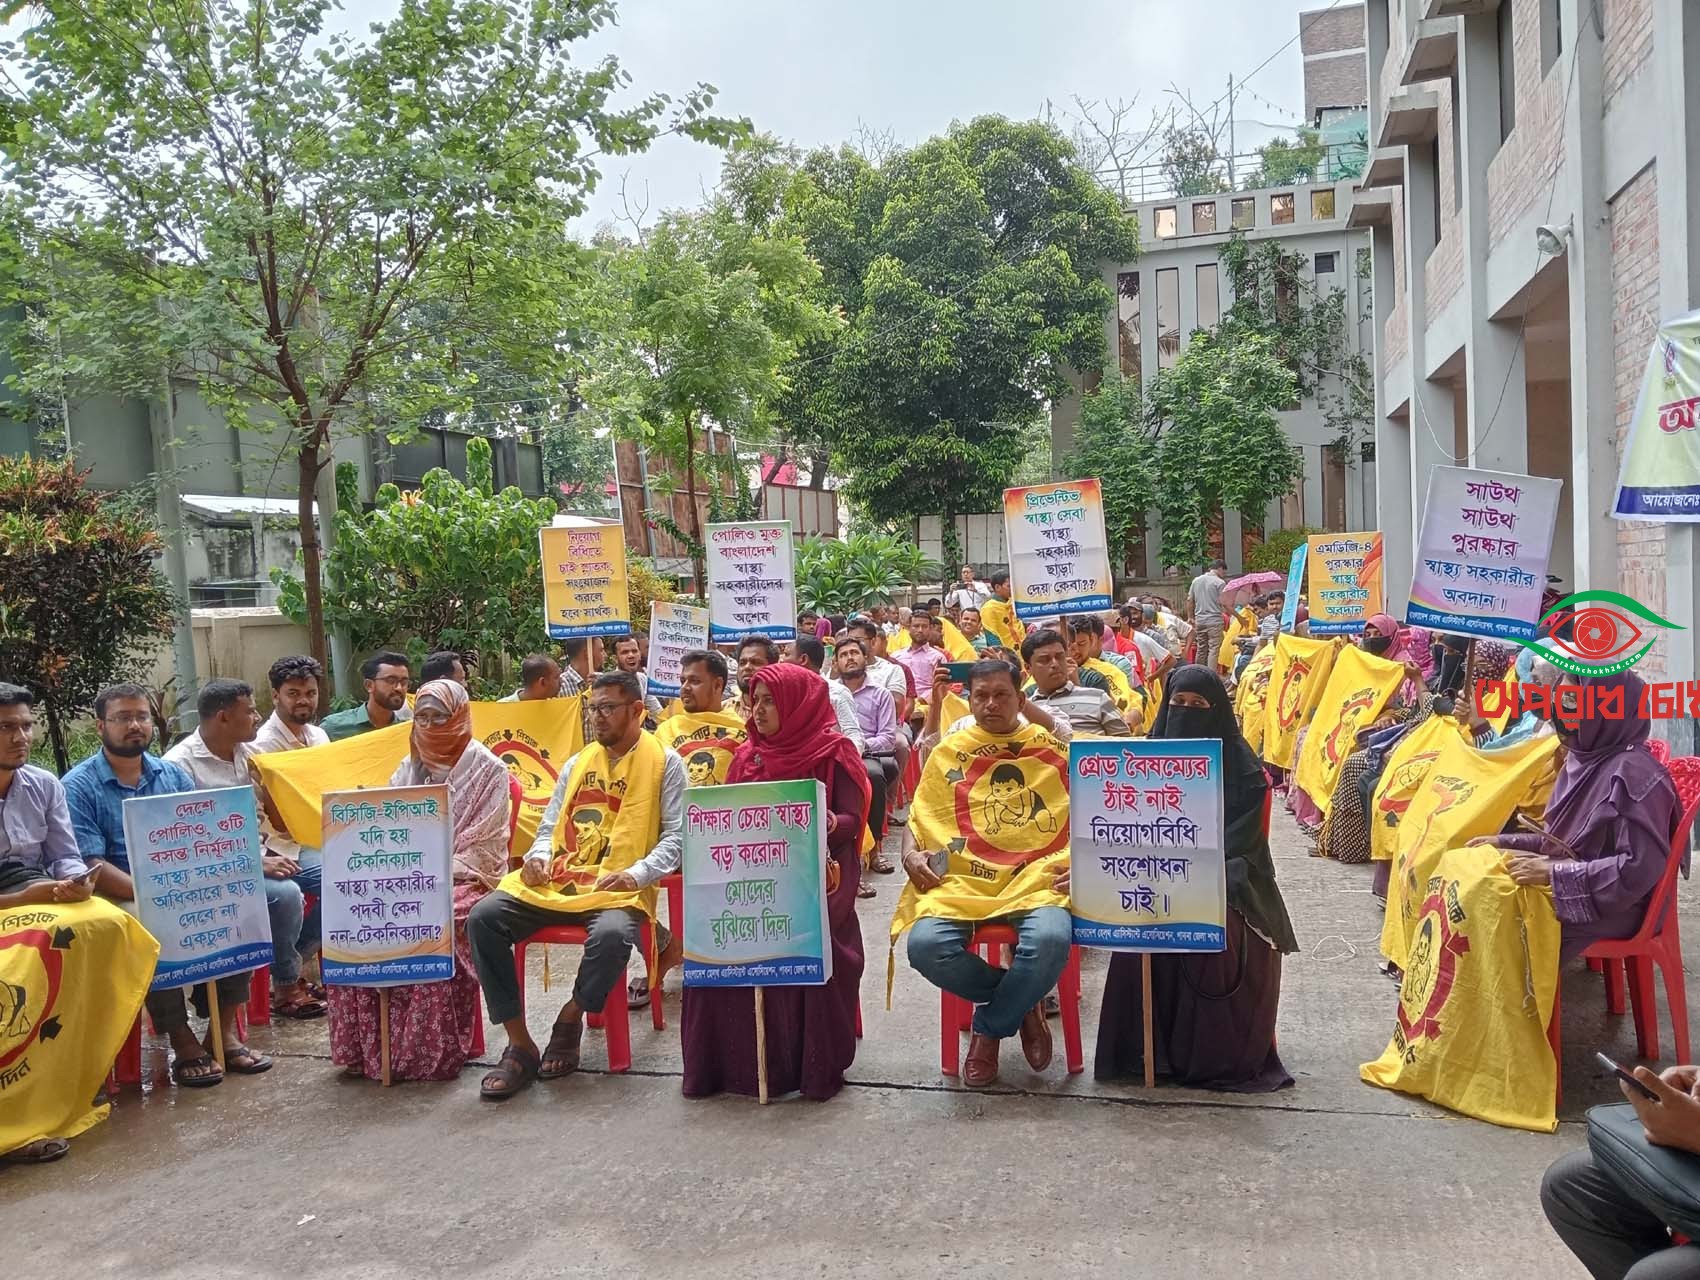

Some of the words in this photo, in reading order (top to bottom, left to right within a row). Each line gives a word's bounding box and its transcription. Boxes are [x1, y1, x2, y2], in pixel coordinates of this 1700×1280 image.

[1025, 489, 1082, 507] প্রিভেন্টিভ
[1466, 480, 1520, 503] সাউথ
[1024, 511, 1053, 525] স্বাস্থ্য
[1057, 508, 1086, 521] সেবা
[1461, 506, 1517, 529] সাউথ
[568, 529, 600, 543] নিয়োগ
[712, 527, 755, 541] পোলিও
[759, 528, 783, 541] মুক্ত
[1041, 527, 1071, 541] স্বাস্থ্য
[568, 545, 602, 558] বিধিতে
[719, 545, 777, 558] বাংলাদেশ
[1035, 540, 1081, 559] সহকারী
[1315, 540, 1373, 553] এমডিজি-৪
[559, 562, 577, 573] চাই
[733, 562, 765, 575] স্বাস্থ্য
[1045, 561, 1074, 577] ছাড়া
[1424, 559, 1462, 579] স্বাস্থ্য
[1467, 564, 1537, 587] সহকারীর
[715, 576, 783, 592] সহকারীদের
[1330, 574, 1358, 585] স্বাস্থ্য
[574, 592, 603, 603] করলে
[734, 592, 767, 606] অর্জন
[1027, 583, 1051, 596] দেয়
[1320, 587, 1369, 601] সহকারীর
[560, 609, 580, 619] হবে
[733, 612, 770, 623] অশেষ
[1325, 605, 1364, 616] অবদান
[1078, 754, 1120, 778] গ্রেড
[1123, 749, 1210, 779] বৈষম্যের
[1103, 780, 1139, 812] ঠাঁই
[1143, 785, 1184, 812] নাই
[176, 800, 214, 818] দেশে
[330, 799, 438, 824] বিসিজি-ইপিআই
[687, 803, 733, 834] শিক্ষার
[737, 806, 771, 831] চেয়ে
[774, 801, 812, 831] স্বাস্থ্য
[148, 823, 211, 845] পোলিও,
[217, 814, 247, 833] গুটি
[359, 826, 385, 846] যদি
[389, 827, 410, 846] হয়
[1089, 815, 1198, 846] নিয়োগবিধি
[148, 846, 188, 865] বসন্ত
[347, 850, 423, 872] টেকনিক্যাল
[710, 843, 734, 871] বড়
[737, 838, 789, 867] করোনা
[151, 868, 189, 888] স্বাস্থ্য
[196, 855, 252, 879] সহকারী
[1099, 855, 1191, 880] সংশোধন
[152, 884, 221, 909] অধিকারে
[226, 878, 257, 896] ছাড়
[334, 879, 369, 897] স্বাস্থ্য
[374, 871, 437, 895] সহকারীর
[725, 877, 777, 905] মোদের
[178, 909, 216, 928] দেবে
[220, 903, 238, 918] না
[350, 897, 386, 920] পদবী
[392, 900, 423, 919] কেন
[2, 912, 58, 931] শিশুকে
[710, 910, 758, 947] বুঝিয়ে
[760, 907, 791, 940] দিল
[329, 922, 442, 947] নন-টেকনিক্যাল?
